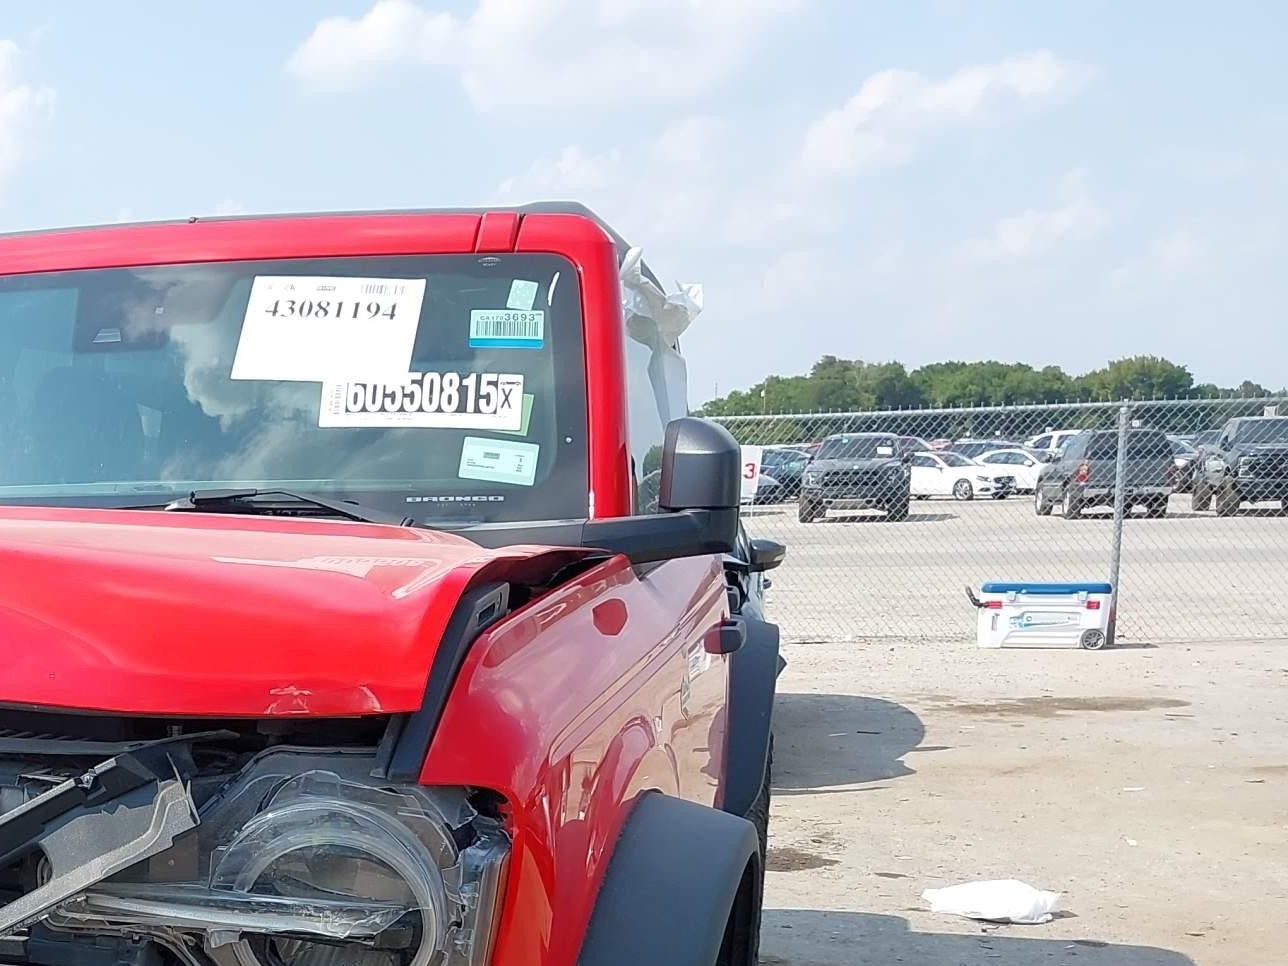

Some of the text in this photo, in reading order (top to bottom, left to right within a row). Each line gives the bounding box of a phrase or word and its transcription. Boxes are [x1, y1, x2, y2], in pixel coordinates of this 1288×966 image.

[264, 299, 398, 321] 43081194
[346, 372, 498, 414] 60550815
[744, 463, 755, 479] 3
